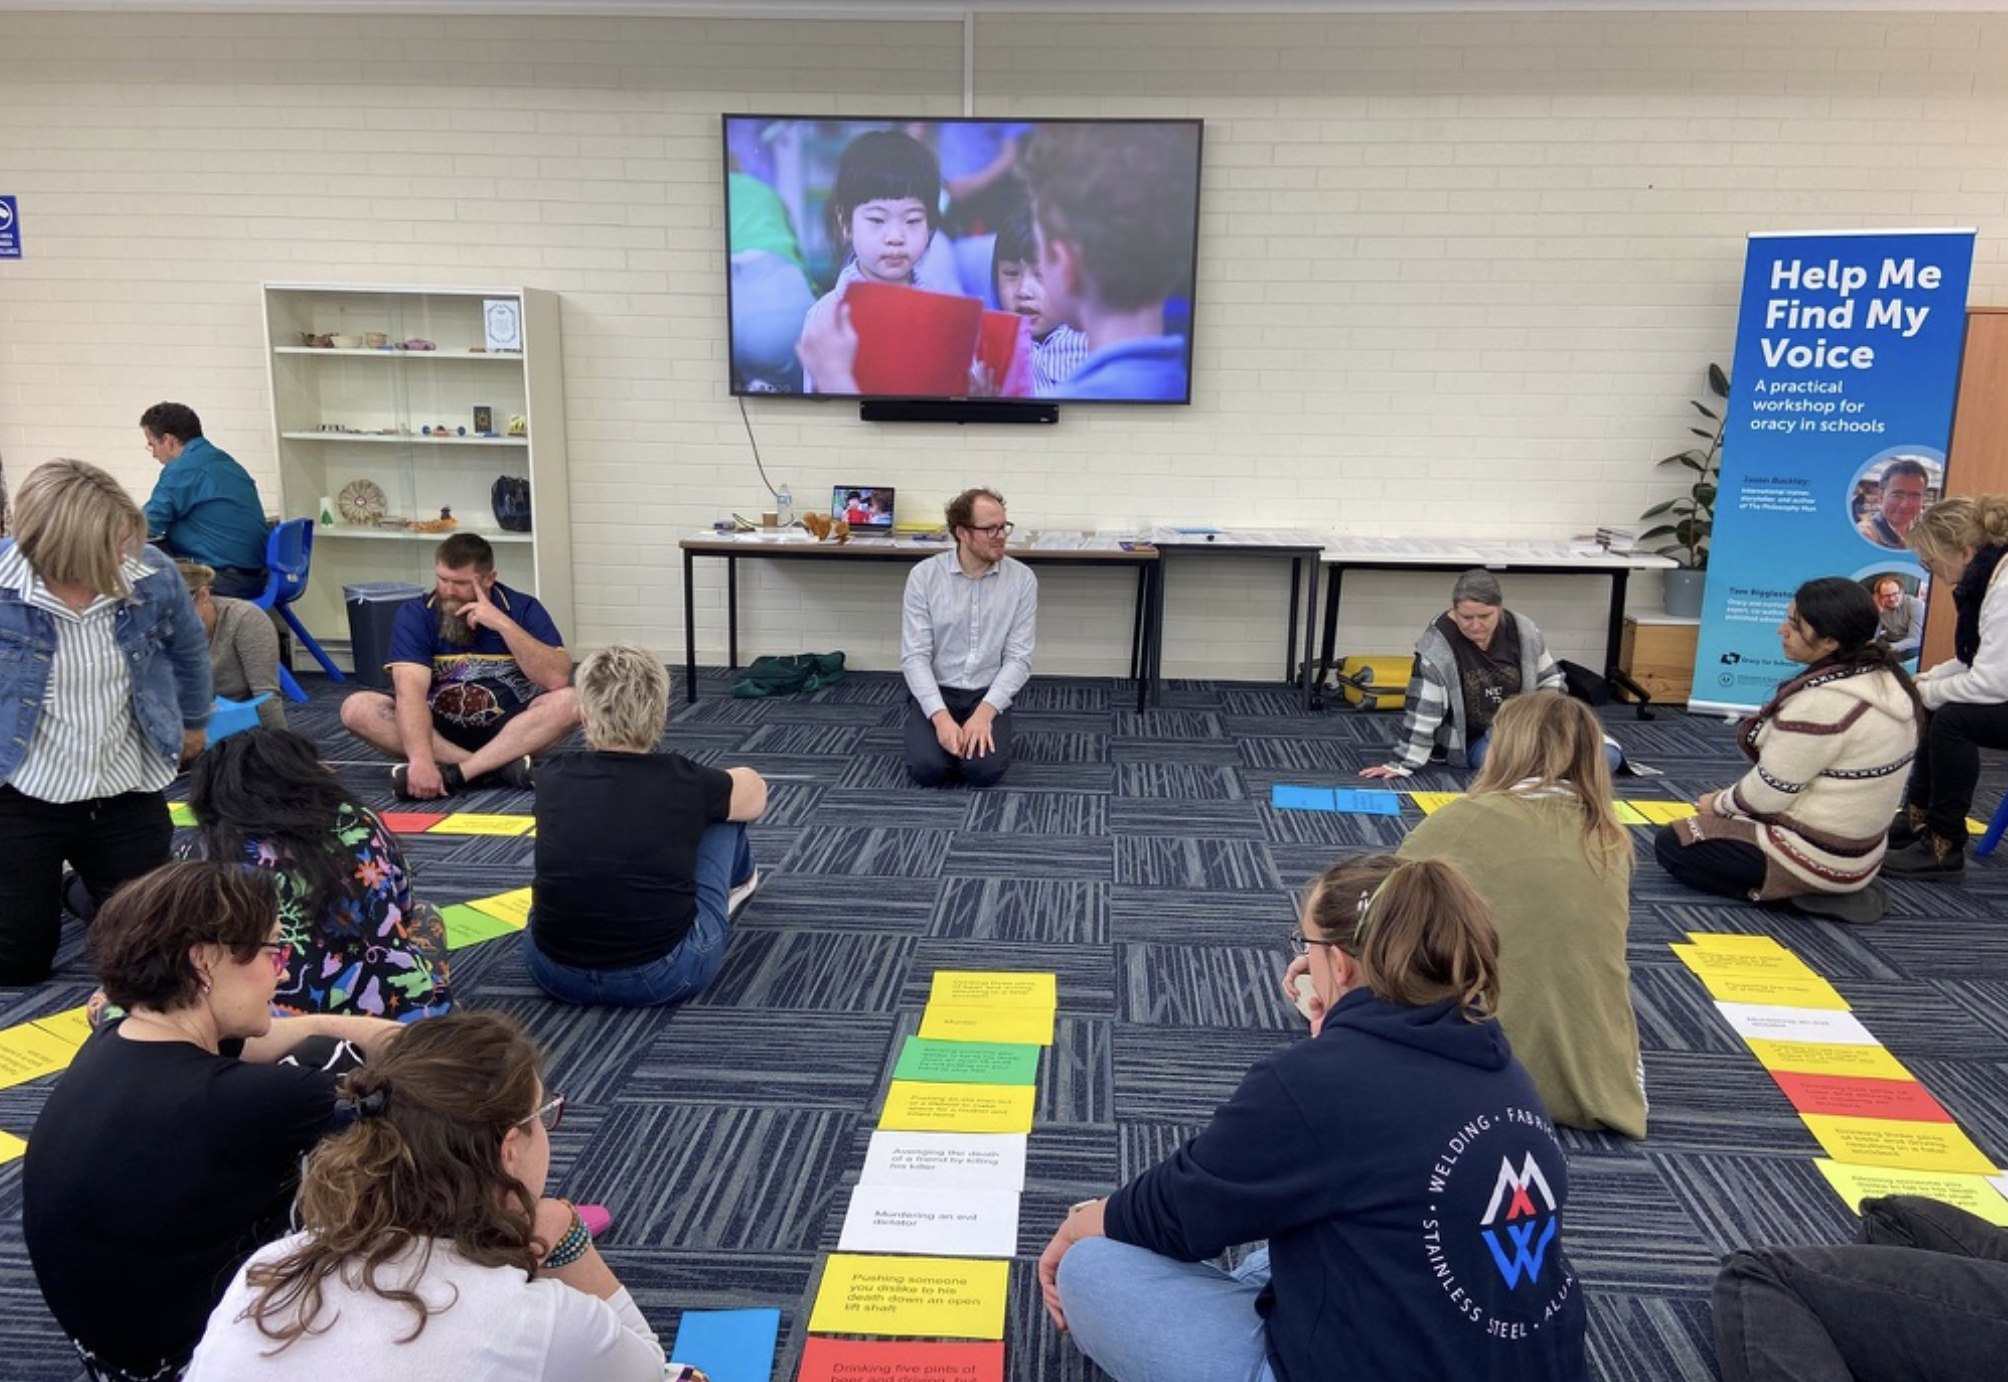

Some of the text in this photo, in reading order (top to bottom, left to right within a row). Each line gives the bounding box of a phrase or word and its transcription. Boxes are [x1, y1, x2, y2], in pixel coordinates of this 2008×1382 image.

[1770, 258, 1942, 297] Help Me
[1765, 299, 1931, 337] Find My
[1760, 338, 1875, 369] Voice
[1754, 379, 1843, 395] A practical
[1752, 399, 1865, 415] workshop for
[1750, 417, 1885, 434] oracy in schools
[893, 1147, 1000, 1158] Avenging the death
[1428, 1114, 1491, 1193] WELDING
[891, 1155, 903, 1163] of
[916, 1155, 948, 1163] friend
[950, 1157, 965, 1165] by
[966, 1157, 1000, 1166] killing
[909, 1163, 936, 1171] killer
[874, 1209, 978, 1221] Murdering an evil
[873, 1218, 918, 1227] dictator
[852, 1274, 967, 1285] Pushing someone
[1423, 1219, 1483, 1322] STAINLESS
[1486, 1318, 1528, 1340] STEEL
[849, 1284, 957, 1294] you dislike to his
[847, 1293, 885, 1302] death
[887, 1294, 923, 1304] down
[947, 1297, 982, 1306] open
[844, 1303, 897, 1313] lift shaft
[833, 1362, 978, 1374] Drinking five pints of
